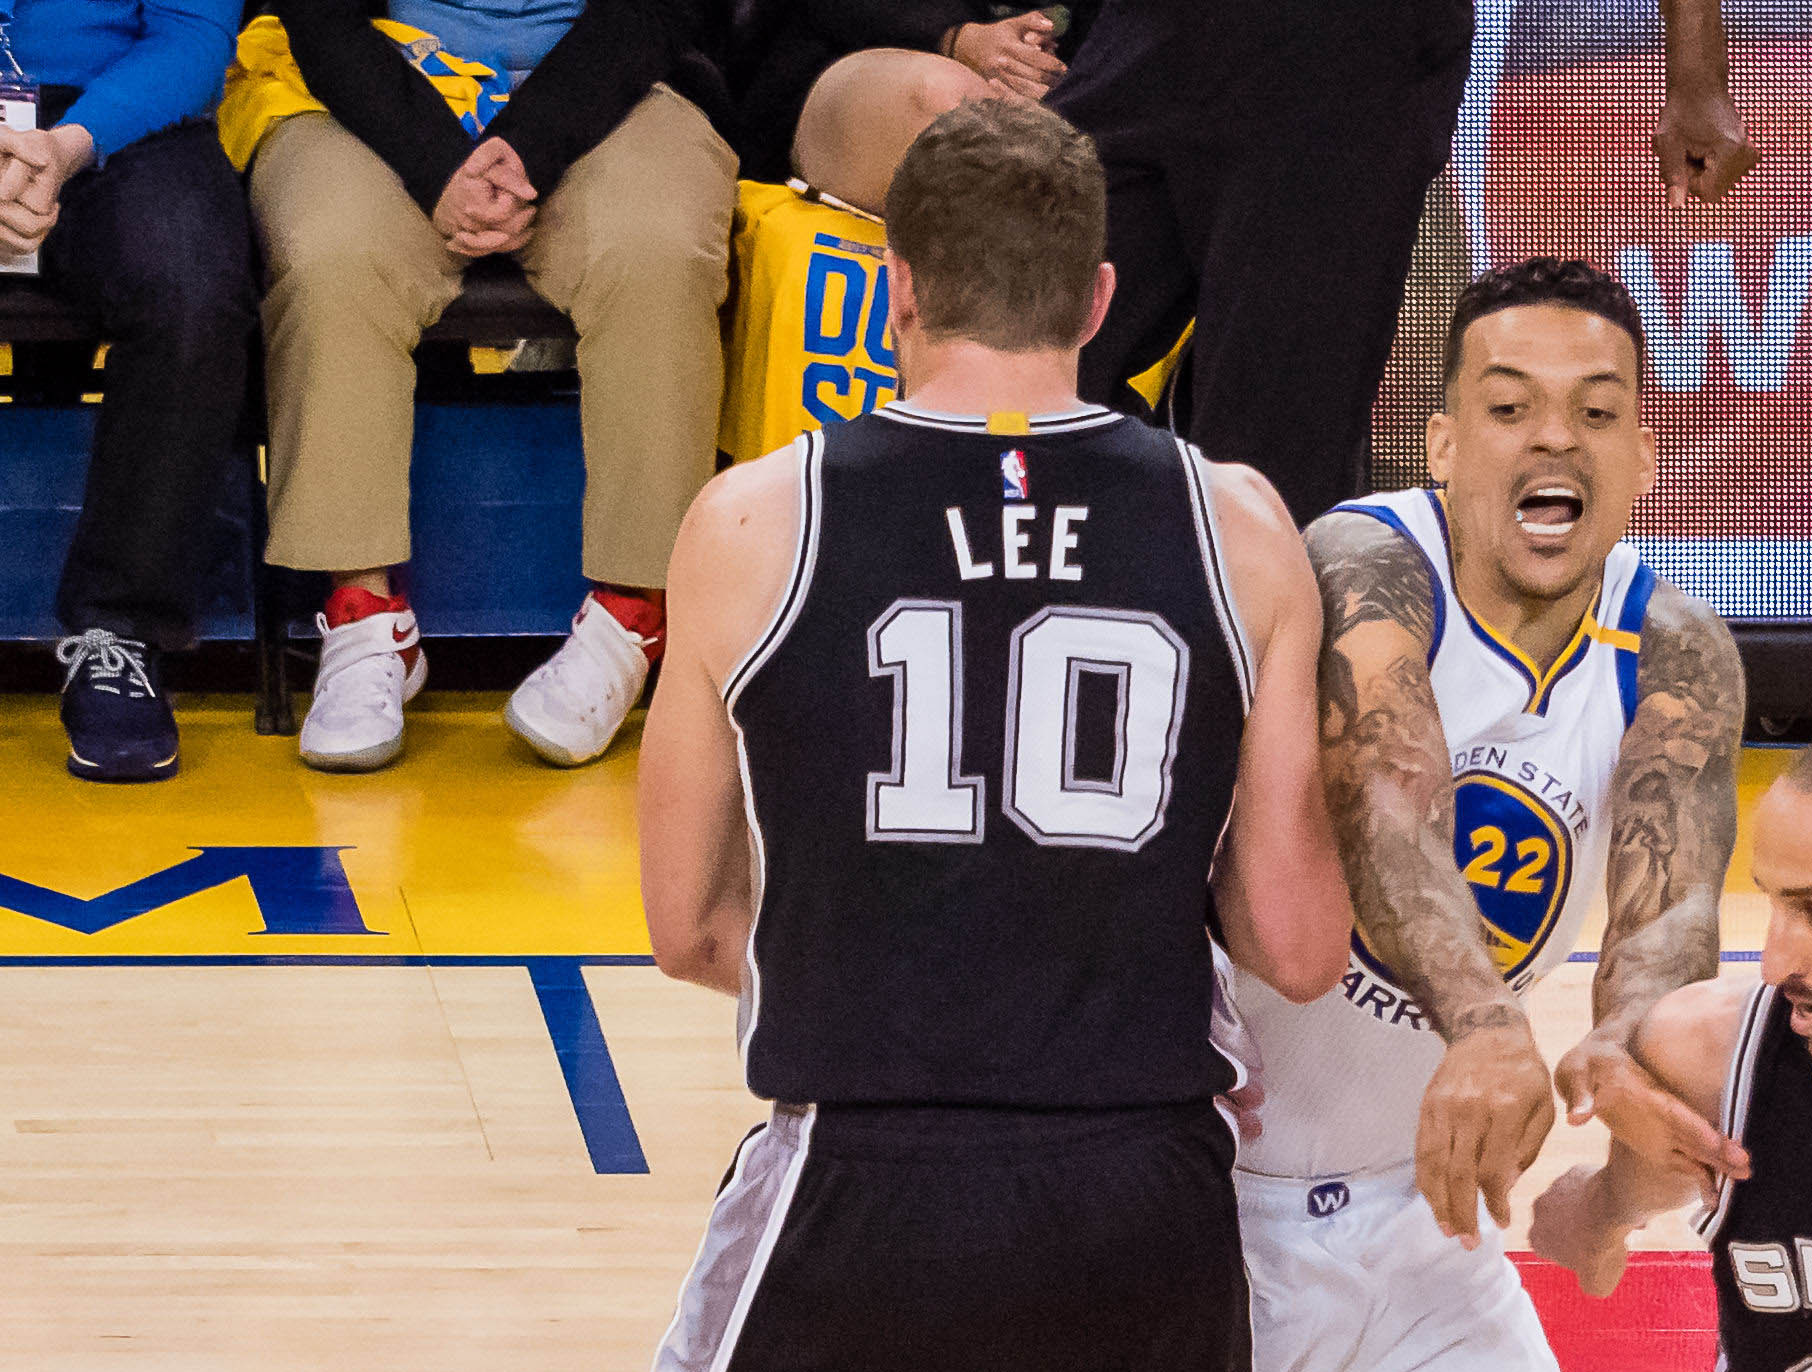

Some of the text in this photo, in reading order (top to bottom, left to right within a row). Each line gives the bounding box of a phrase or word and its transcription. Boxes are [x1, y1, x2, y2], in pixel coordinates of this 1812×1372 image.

[946, 504, 1088, 582] LEE
[864, 598, 1190, 852] 10
[1450, 746, 1588, 840] DEN STATE
[1463, 824, 1551, 894] 22
[1341, 963, 1430, 1031] ARR
